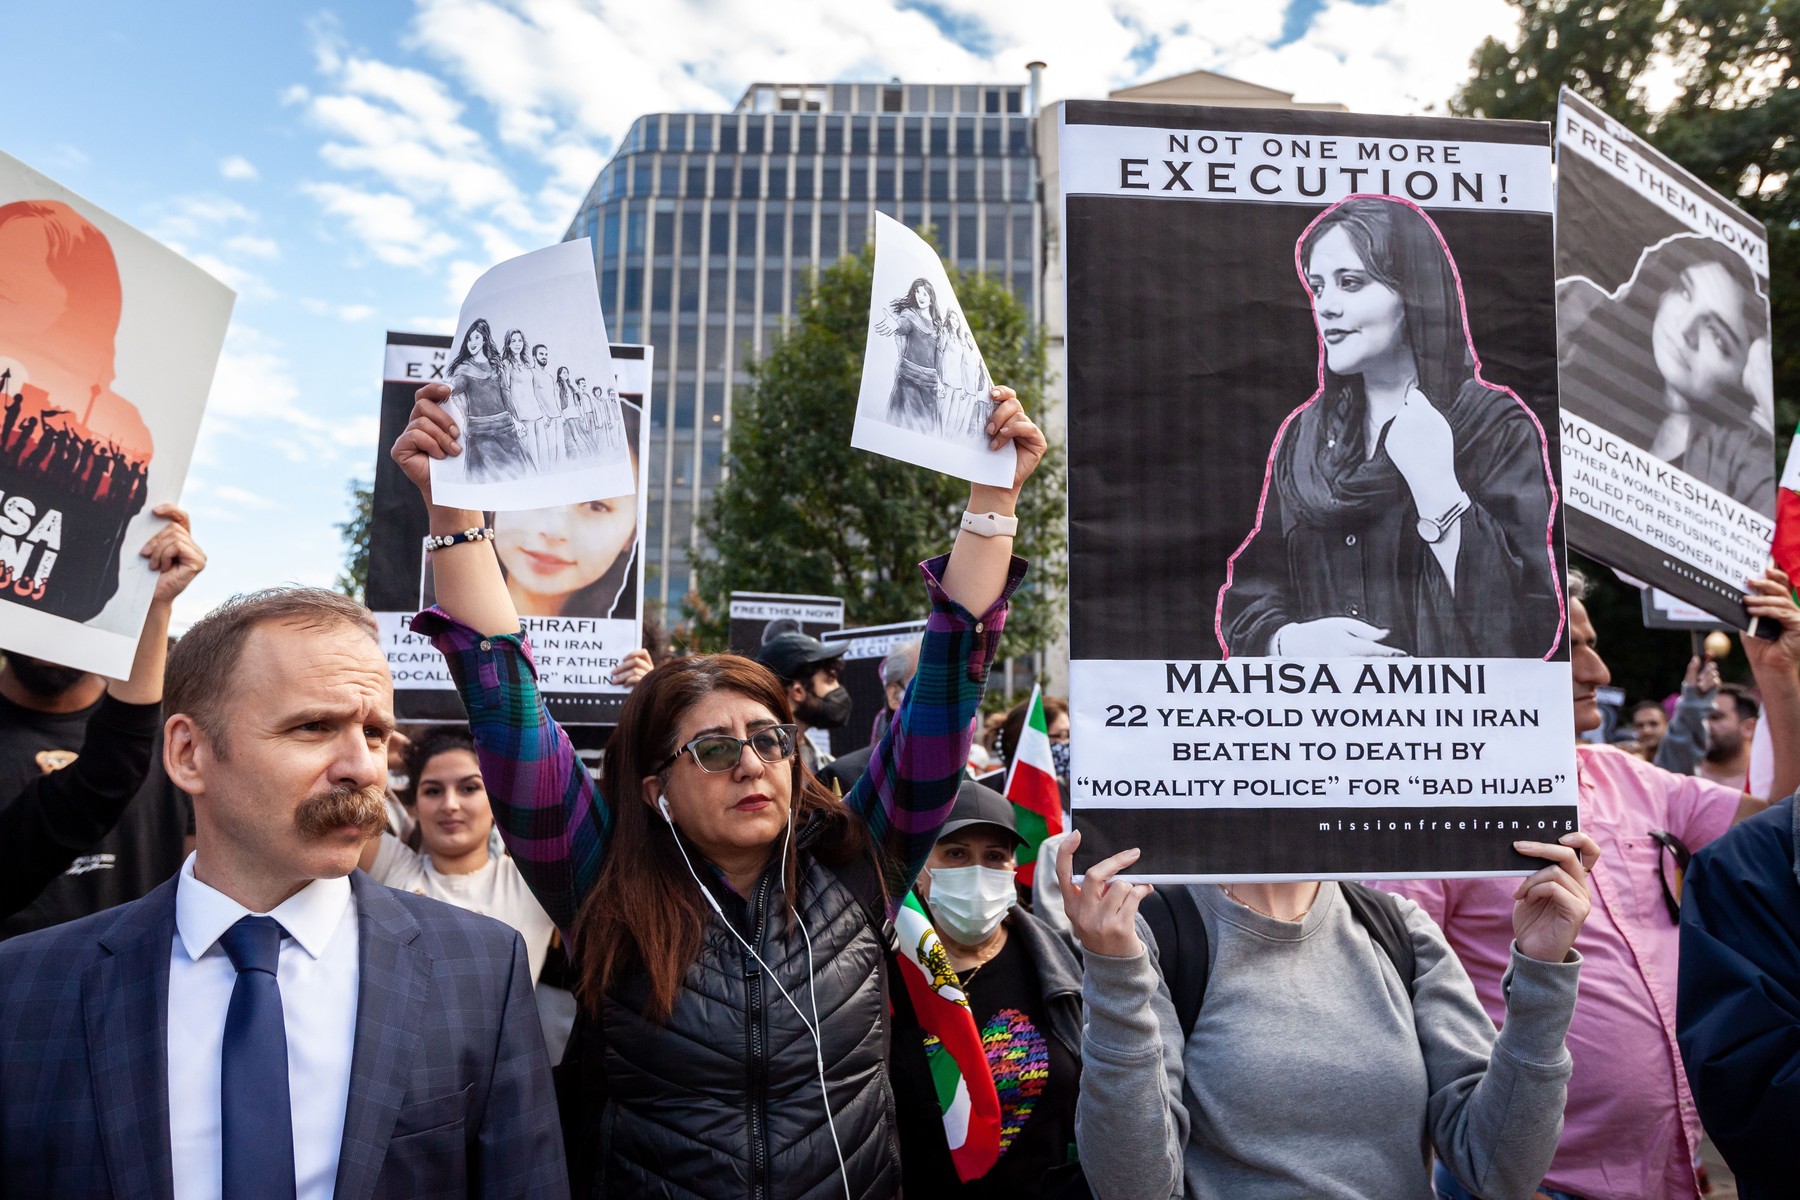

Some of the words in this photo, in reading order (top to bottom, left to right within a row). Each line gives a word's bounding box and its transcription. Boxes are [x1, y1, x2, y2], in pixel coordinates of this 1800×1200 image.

[1169, 134, 1243, 156] NOT
[1262, 138, 1338, 159] ONE
[1358, 142, 1461, 165] MORE
[1119, 157, 1510, 204] EXECUTION!
[1566, 117, 1629, 173] FREE
[1635, 161, 1698, 220] THEM
[1705, 211, 1764, 264] NOW!
[1560, 417, 1650, 477] MOJGAN
[1657, 466, 1773, 544] KESHAVARZ
[1562, 444, 1607, 474] OTHER
[1611, 468, 1620, 480] &
[1622, 472, 1681, 512] WOMEN'S
[1684, 506, 1727, 536] RIGHTS
[1729, 531, 1770, 560] ACTIVIS
[1573, 469, 1623, 500] JAILED
[1626, 494, 1654, 517] FOR
[1657, 510, 1722, 552] REFUSING
[1725, 545, 1760, 573] HIJAB
[1569, 486, 1643, 532] POLITICAL
[1646, 525, 1714, 567] PRISONER
[1716, 560, 1728, 575] IN
[1731, 570, 1750, 585] IRA
[733, 605, 765, 615] FREE
[769, 607, 802, 616] THEM
[805, 608, 840, 618] NOW!
[519, 618, 596, 633] SHRAFI
[544, 639, 559, 649] IN
[565, 640, 603, 650] IRAN
[533, 656, 551, 666] ER
[557, 656, 619, 668] FATHER
[390, 671, 453, 680] SO-CALL
[563, 674, 613, 685] KILLIN
[1164, 662, 1342, 695] MAHSA
[1352, 663, 1487, 695] AMINI
[1104, 704, 1149, 728] 22
[1157, 708, 1303, 728] YEAR-OLD
[1311, 708, 1426, 728] WOMAN
[1435, 708, 1464, 728] IN
[1472, 708, 1540, 728] IRAN
[1172, 742, 1291, 762] BEATEN
[1299, 742, 1337, 762] TO
[1345, 742, 1443, 761] DEATH
[1451, 742, 1486, 761] BY
[1076, 776, 1226, 797] “MORALITY
[1233, 776, 1340, 797] POLICE”
[1348, 778, 1400, 796] FOR
[1408, 776, 1473, 796] “BAD
[1481, 774, 1566, 796] HIJAB”
[1318, 818, 1573, 832] missionfreeiran.org
